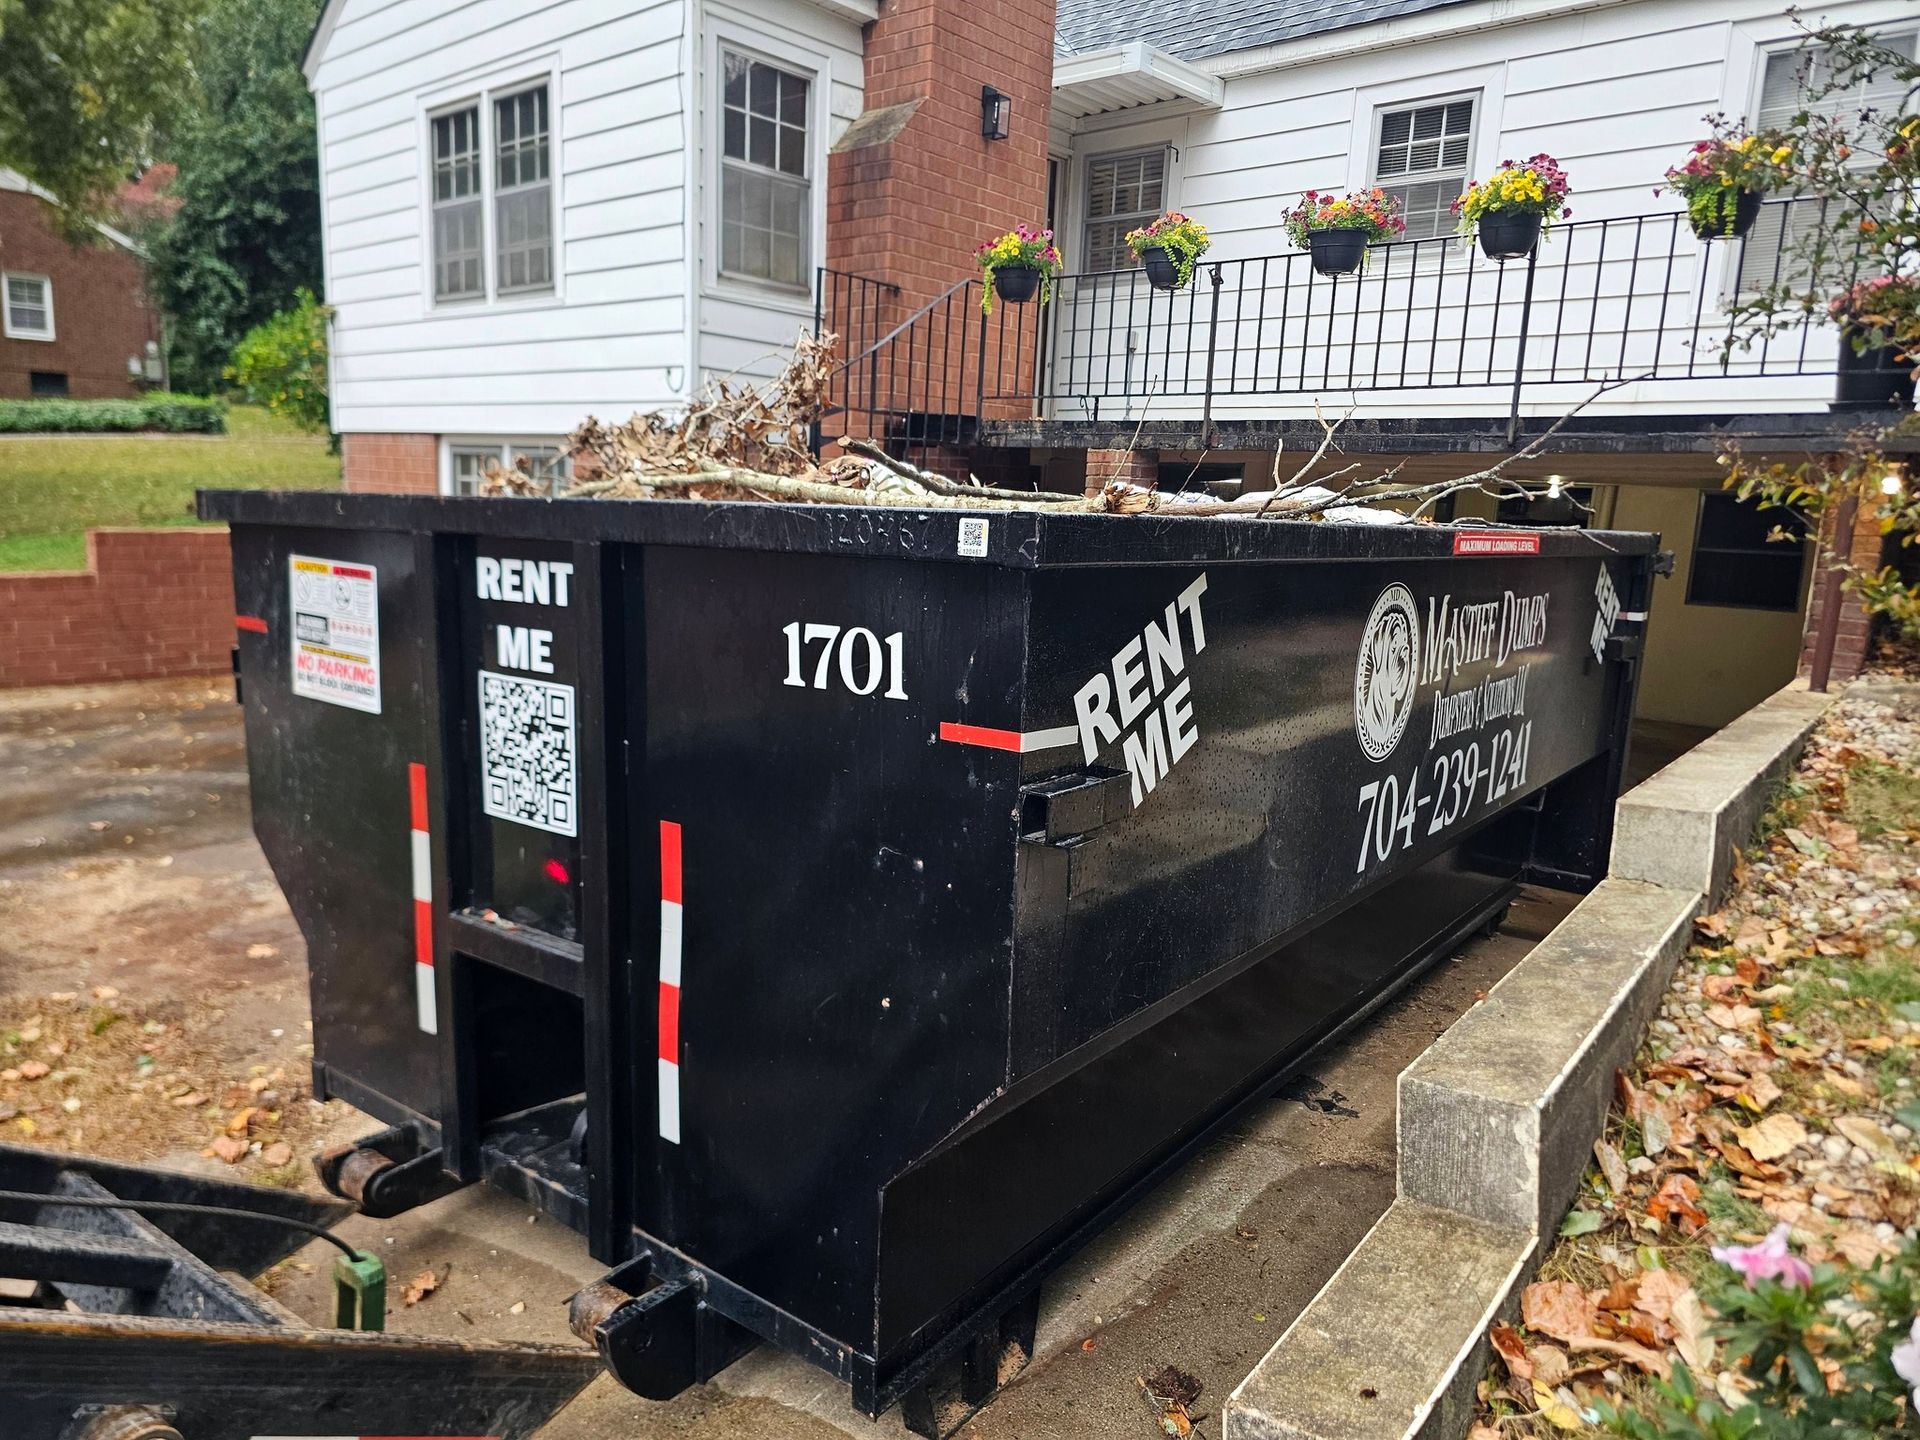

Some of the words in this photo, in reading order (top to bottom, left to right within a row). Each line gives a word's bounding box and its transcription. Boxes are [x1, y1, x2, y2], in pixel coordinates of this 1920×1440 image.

[1459, 541, 1492, 551] MAXIMUM
[1492, 541, 1517, 551] LOADING
[1518, 541, 1535, 551] LEVEL
[476, 556, 574, 607] RENT
[1594, 560, 1620, 633] RENT
[297, 654, 314, 672] NO
[318, 659, 375, 685] PARKING
[496, 624, 555, 674] ME
[782, 621, 910, 700] 1701
[1073, 572, 1208, 767] RENT
[1590, 610, 1608, 665] ME
[1122, 676, 1200, 810] ME
[1357, 719, 1533, 874] 704-239-1241
